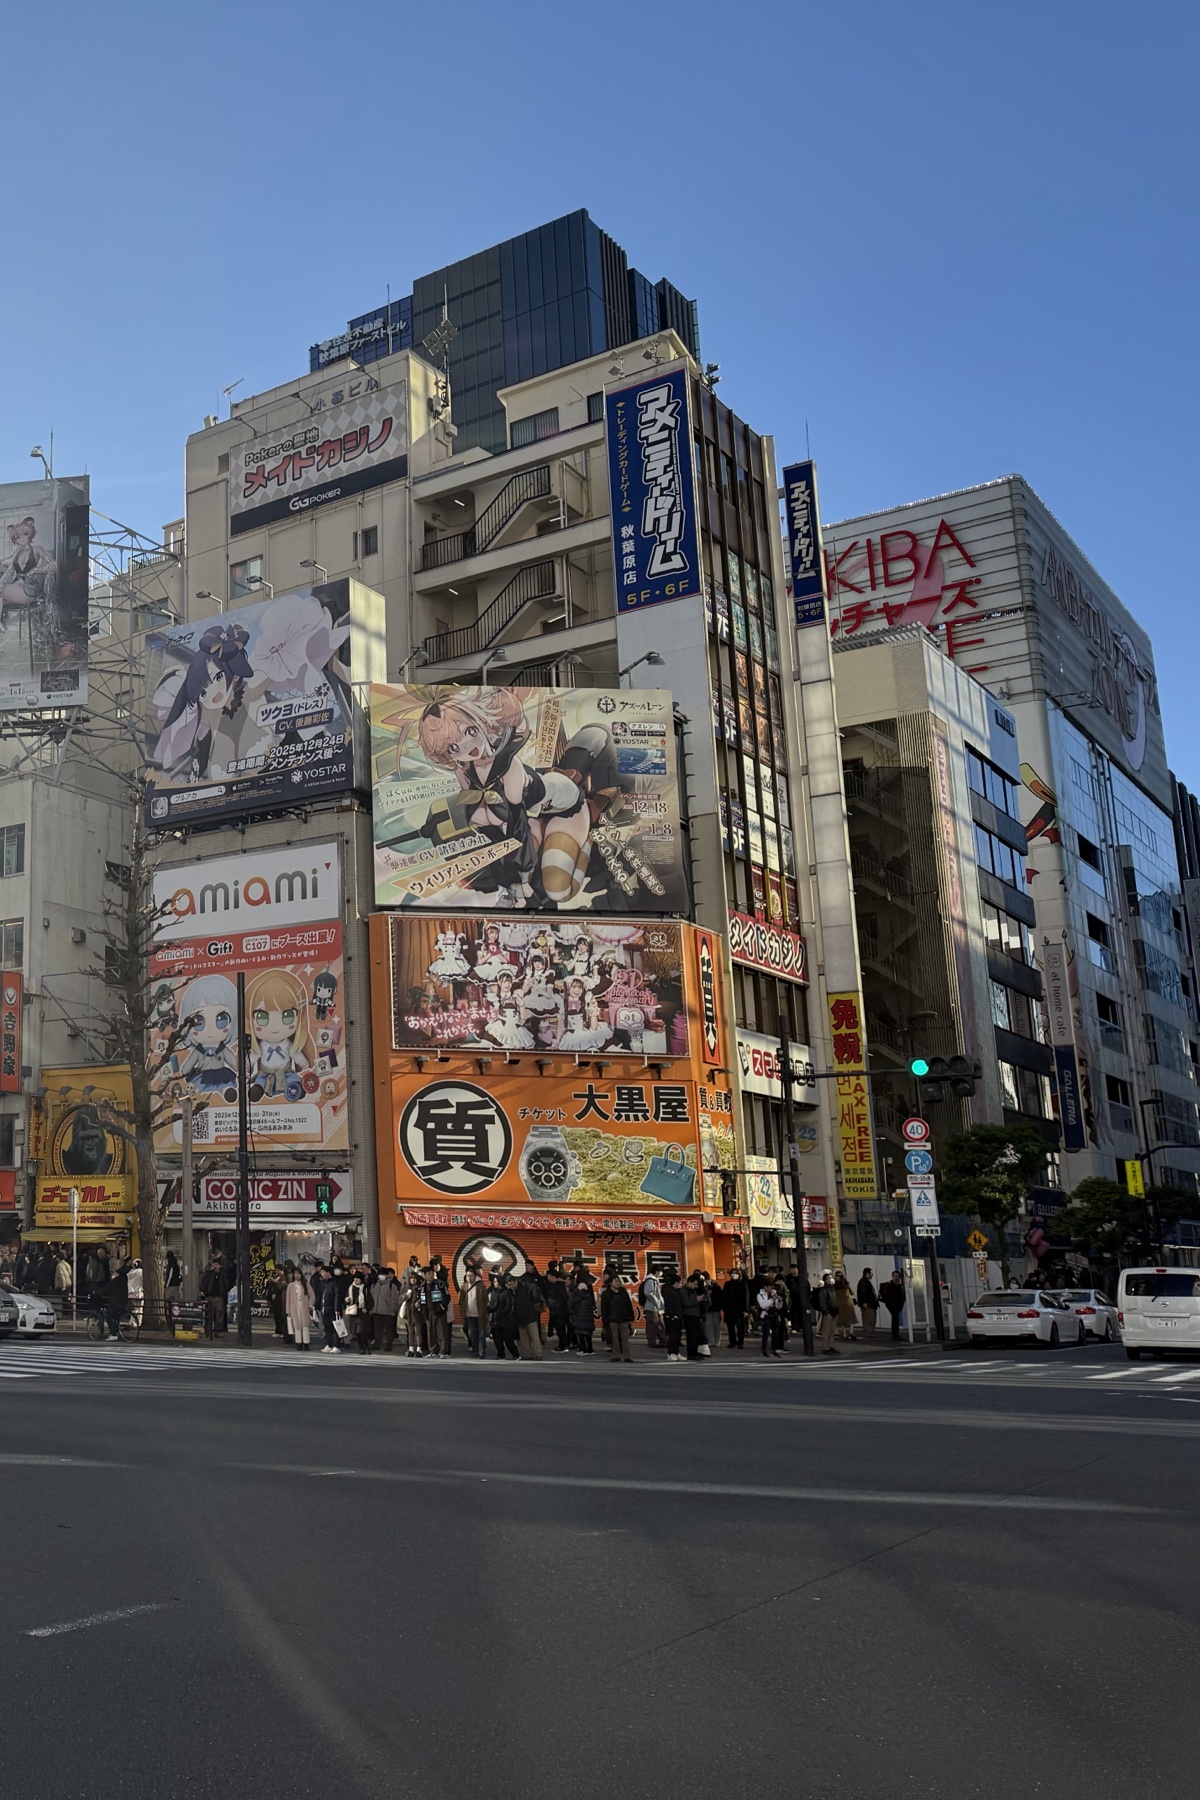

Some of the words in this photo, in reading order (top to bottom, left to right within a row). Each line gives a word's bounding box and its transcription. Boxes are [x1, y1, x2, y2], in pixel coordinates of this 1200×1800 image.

[243, 416, 392, 498] メイドカジノ
[245, 427, 319, 467] Pokerの聖地
[616, 409, 631, 507] トレーディングカードゲーム
[620, 525, 637, 585] 秋葉原店
[823, 518, 977, 600] KIBA
[627, 580, 689, 605] 5F・6F
[270, 734, 344, 757] 2025年12月24日
[304, 763, 346, 779] YOSTAR
[633, 801, 667, 813] 12.18
[650, 823, 672, 835] 1.8
[419, 851, 435, 862] CV
[439, 834, 487, 856] 諸星すみれ
[410, 840, 520, 894] ウィリアム・D・ポーター
[171, 868, 318, 917] amiami
[155, 947, 194, 962] amiami
[207, 940, 234, 958] Gift
[245, 941, 268, 951] C107
[271, 929, 336, 949] にブース出展!
[730, 917, 805, 975] メイドカジノ
[436, 1023, 480, 1039] これからも。
[831, 999, 862, 1064] 免税
[1055, 1016, 1066, 1037] cafe
[3, 1011, 16, 1076] 吉野家
[572, 1084, 692, 1124] 大黒屋
[1063, 1069, 1076, 1126] GALLERIA
[518, 1107, 567, 1121] チケット
[414, 1097, 503, 1181] 質
[856, 1114, 872, 1162] FREE
[909, 1125, 923, 1135] 40
[42, 1184, 120, 1203] ゴーゴカレー
[208, 1181, 272, 1199] COIC
[278, 1181, 306, 1199] ZIN
[760, 1175, 771, 1198] 22
[206, 1201, 261, 1211] Akihara
